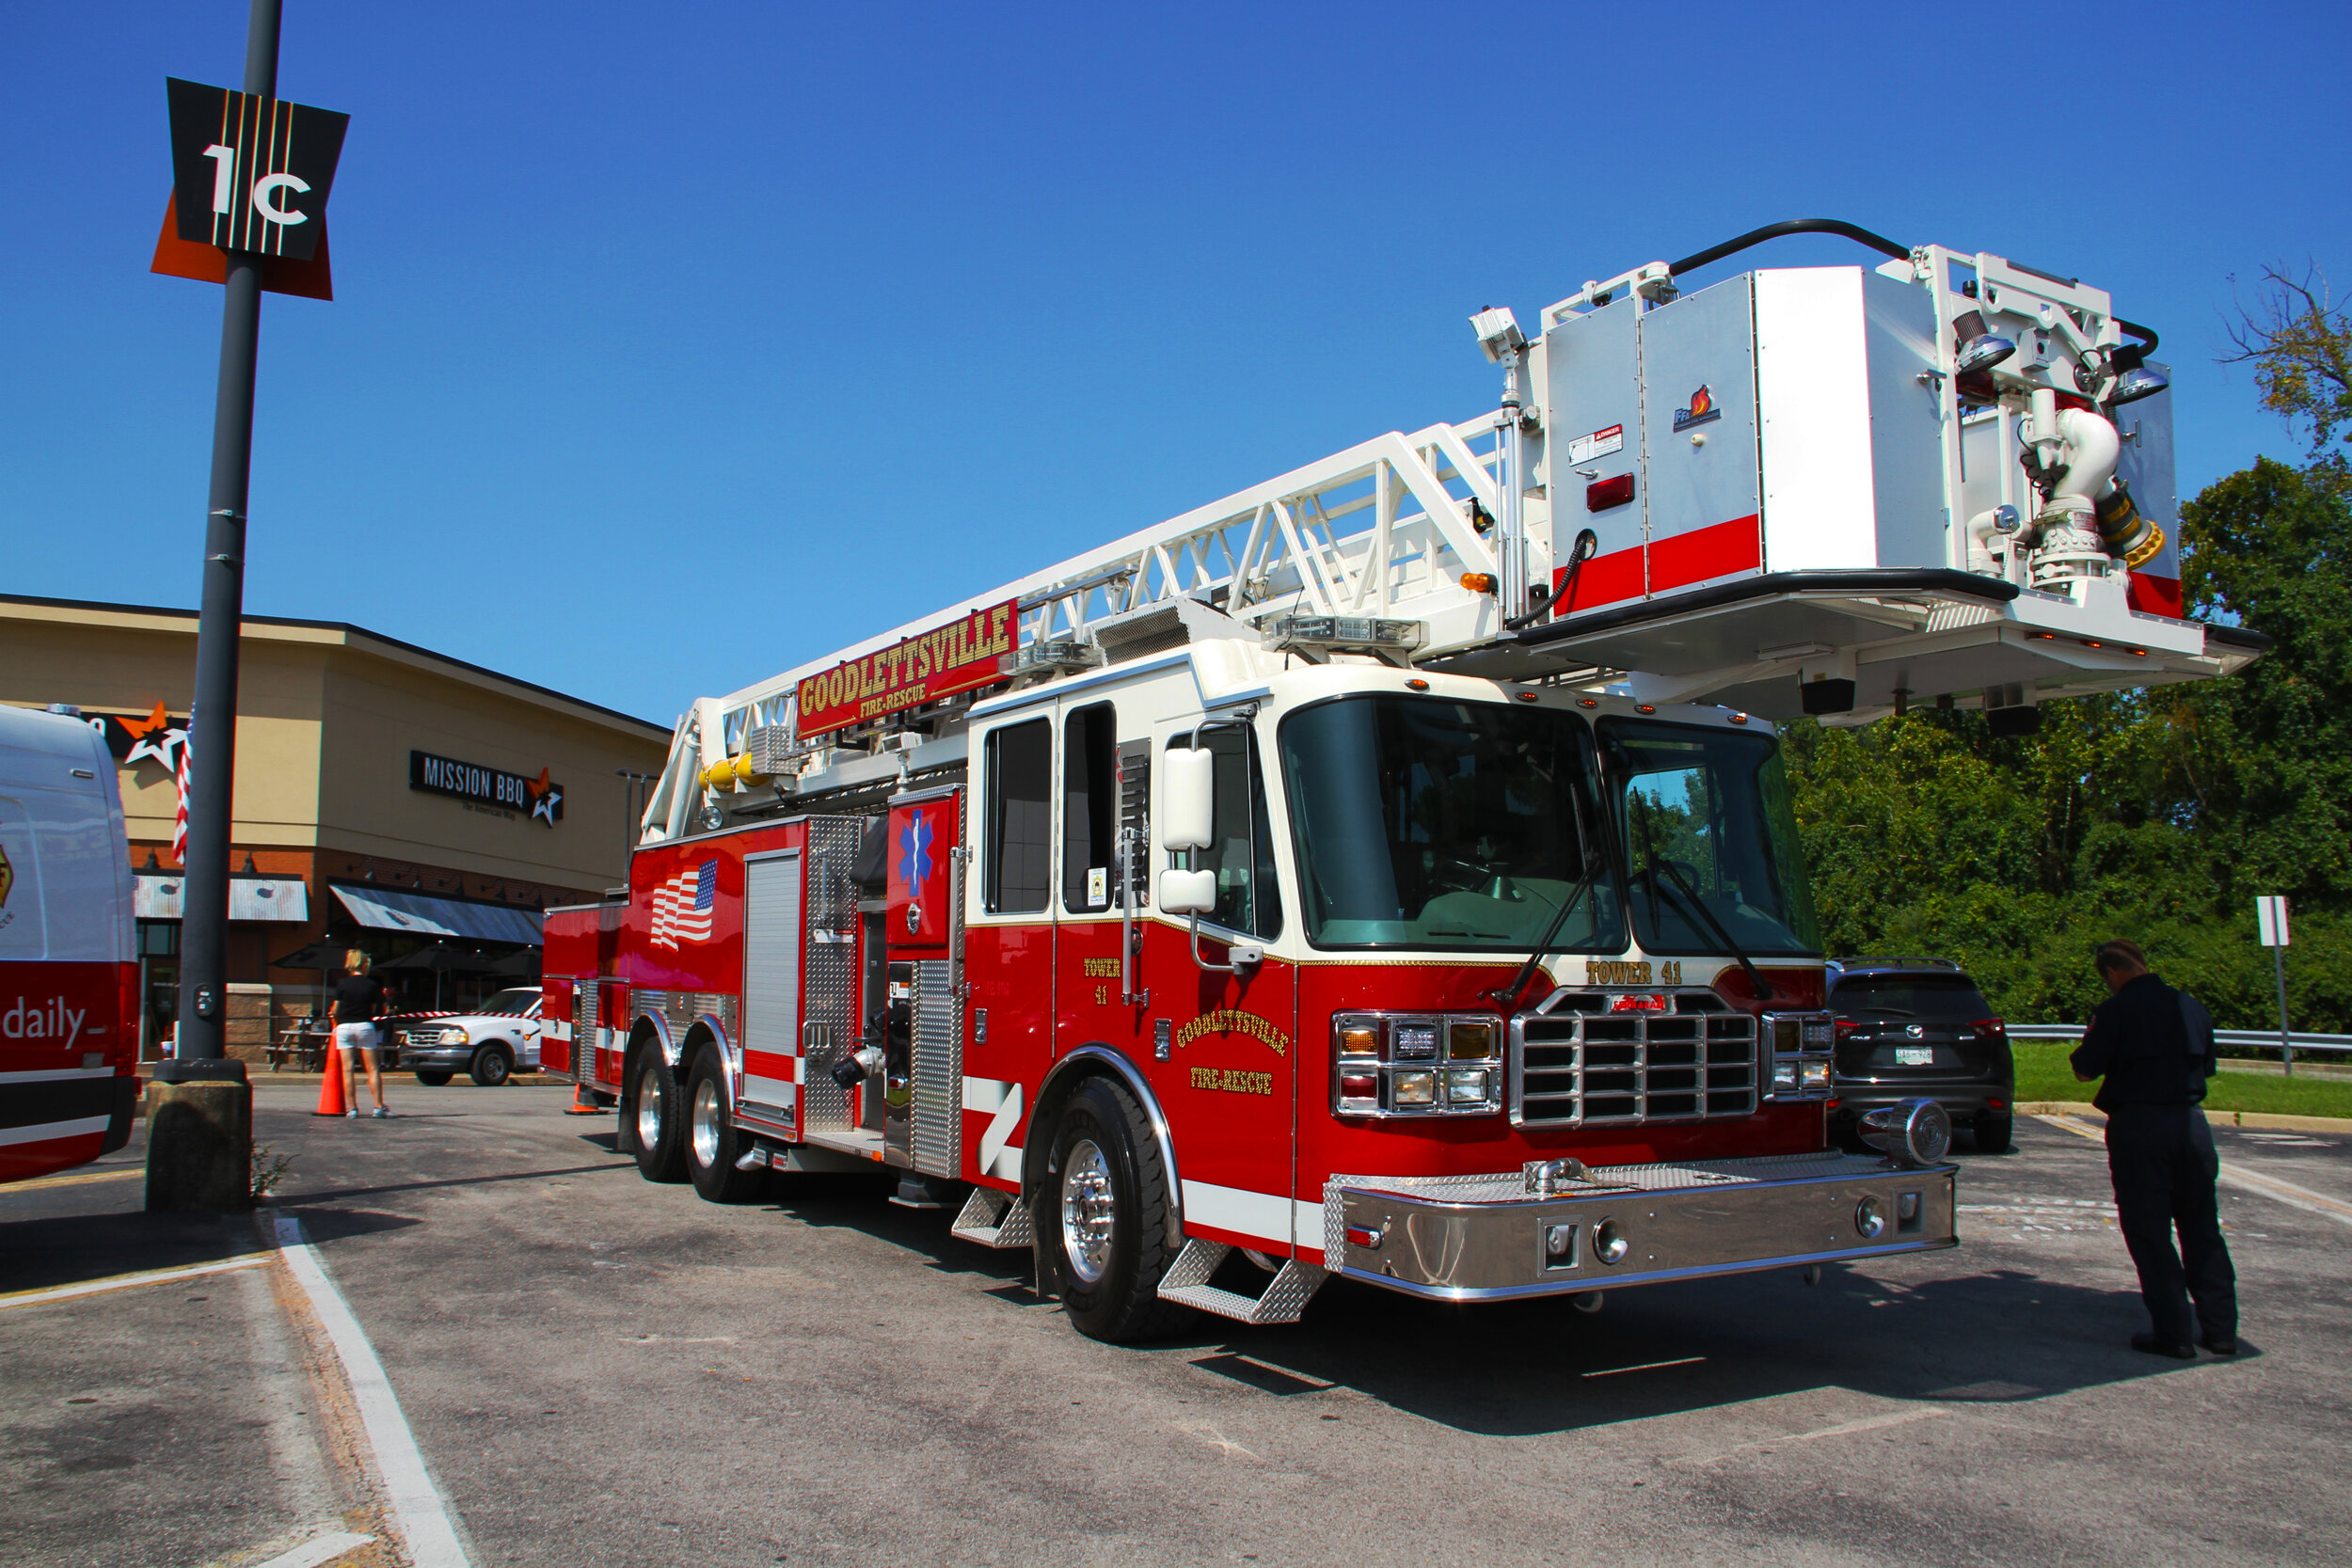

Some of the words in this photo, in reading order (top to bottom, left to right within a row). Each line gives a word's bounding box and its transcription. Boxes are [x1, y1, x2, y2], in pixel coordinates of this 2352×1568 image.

[800, 603, 1010, 718] GOODLETTSVILLE
[860, 682, 927, 719] FIRE-RESCUE
[424, 756, 490, 798] MISSION
[497, 774, 525, 809] BBQ
[1083, 958, 1120, 978] TOWER
[1586, 960, 1652, 984] TOWER
[1661, 960, 1682, 984] 41
[1094, 984, 1107, 1006] 41
[1176, 1008, 1290, 1057] GOODLETTSVILLE
[1190, 1066, 1273, 1096] FIRE-RESCUE
